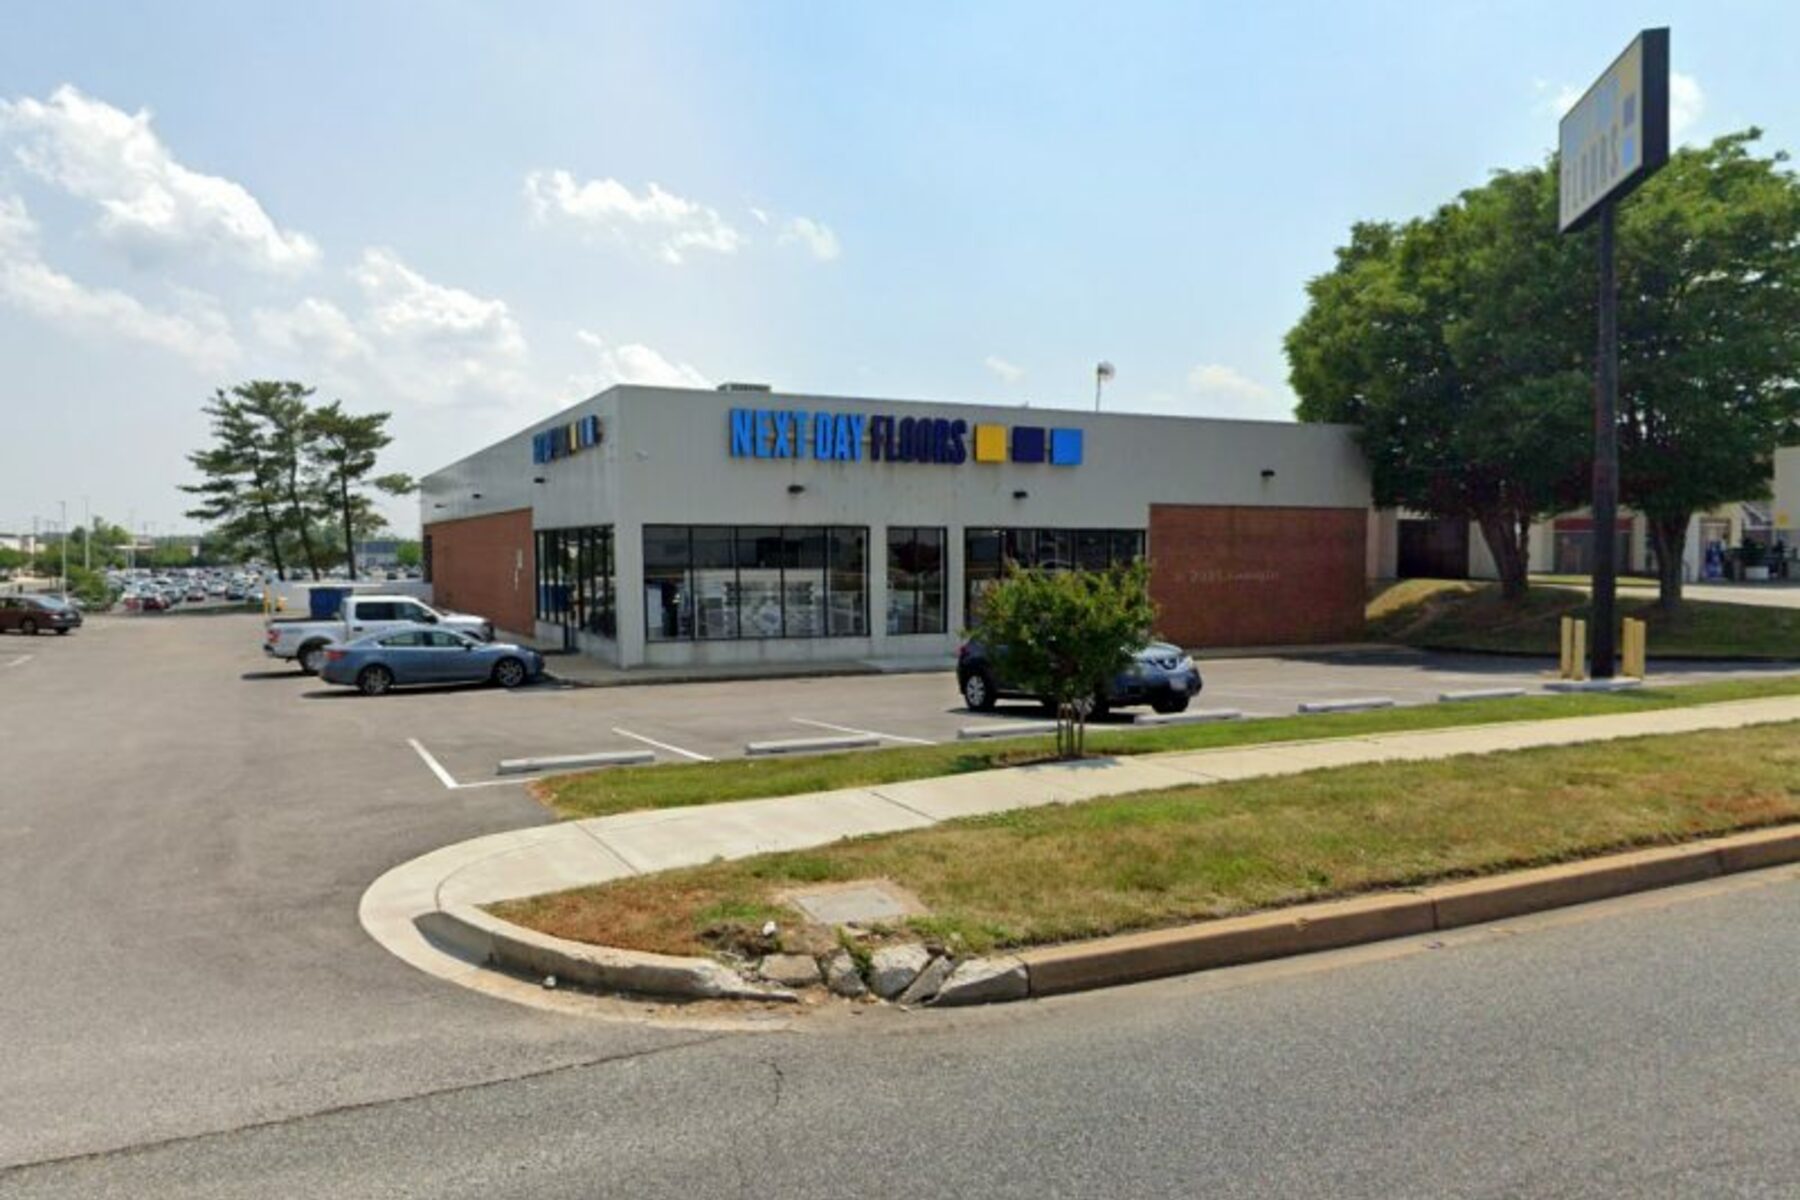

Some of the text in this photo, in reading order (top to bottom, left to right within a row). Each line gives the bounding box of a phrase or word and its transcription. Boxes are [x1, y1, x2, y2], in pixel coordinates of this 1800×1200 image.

[731, 408, 966, 465] NEXT DAY FLOORS
